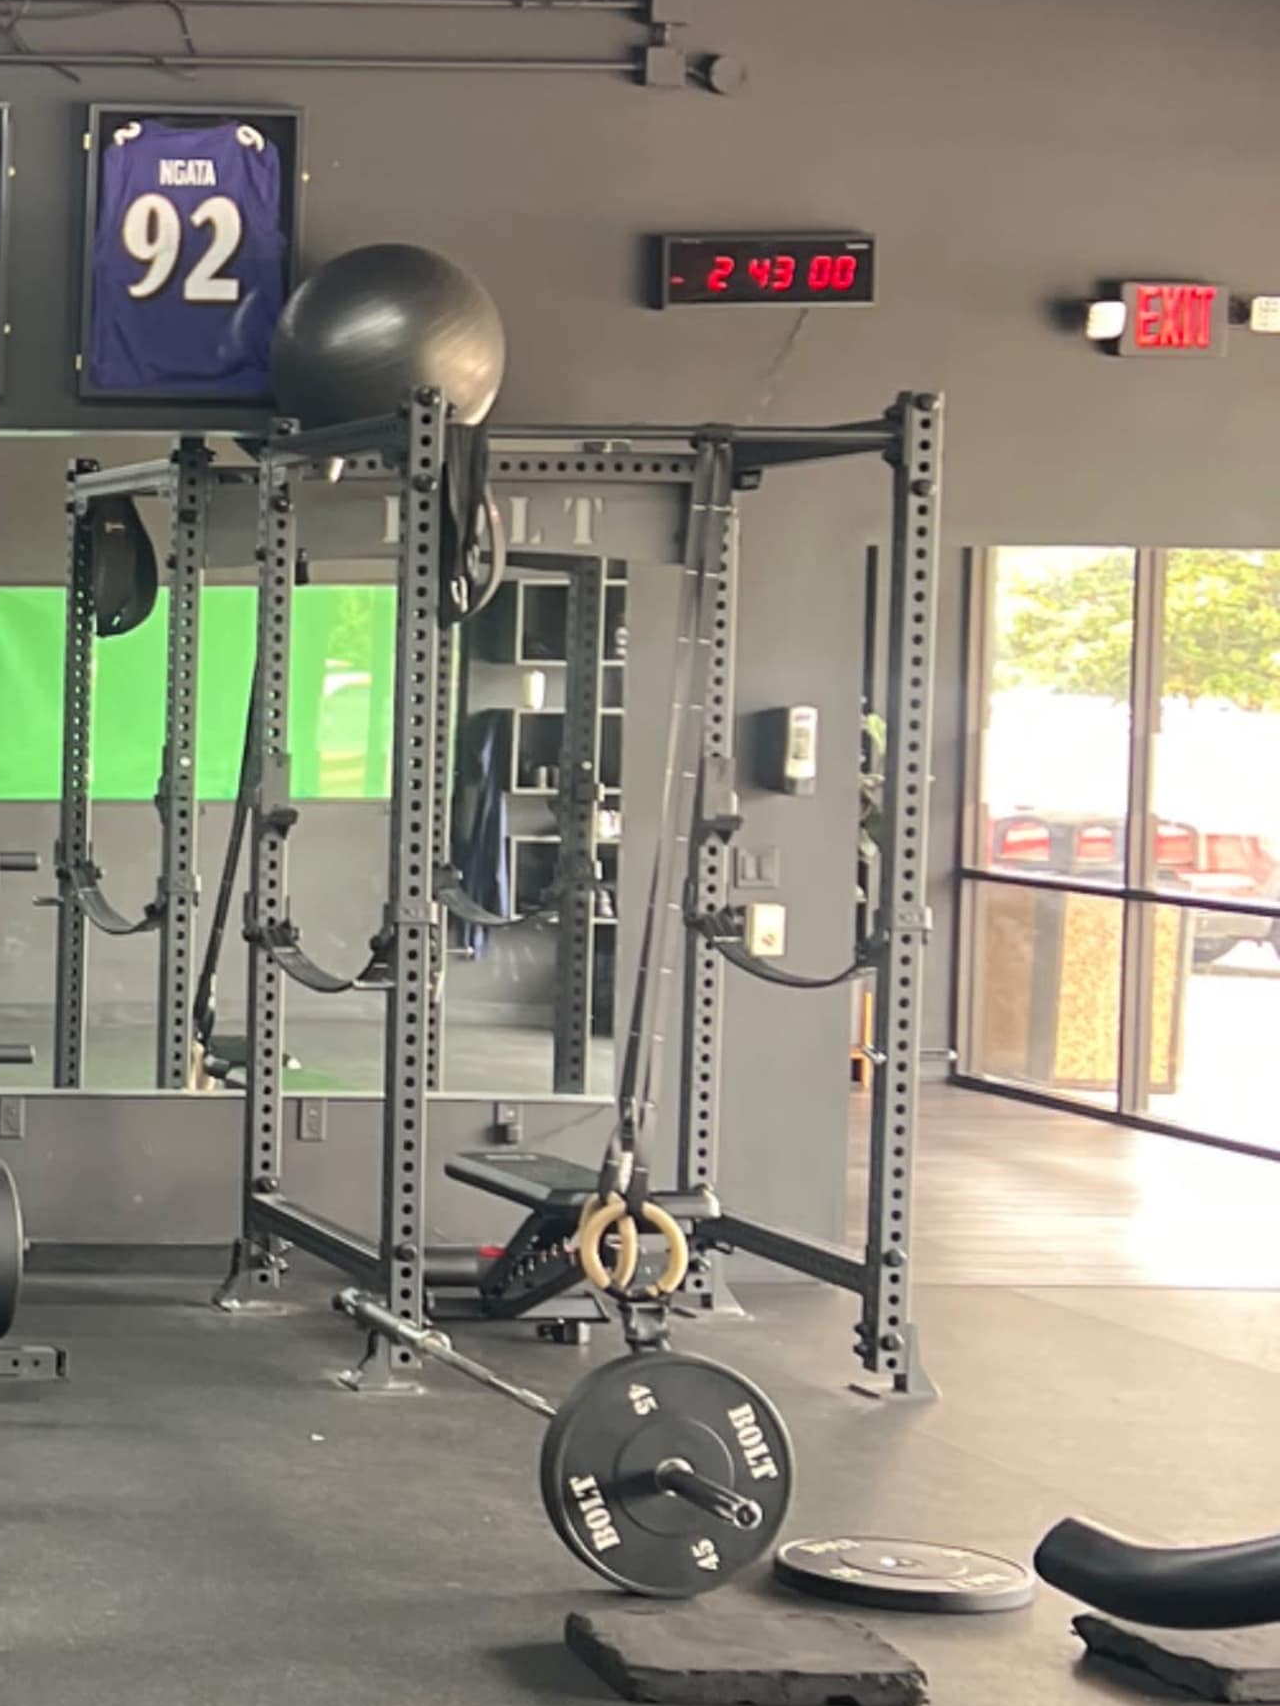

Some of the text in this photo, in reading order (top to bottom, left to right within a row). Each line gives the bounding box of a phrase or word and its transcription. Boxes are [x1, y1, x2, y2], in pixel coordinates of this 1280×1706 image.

[159, 158, 217, 186] NGATA
[121, 192, 243, 302] 92
[707, 255, 857, 291] 2 43 00
[1134, 283, 1219, 349] EXIT
[628, 1382, 659, 1417] 45
[728, 1402, 779, 1481] BOLT
[568, 1474, 623, 1553] BOLT
[690, 1538, 721, 1572] 45
